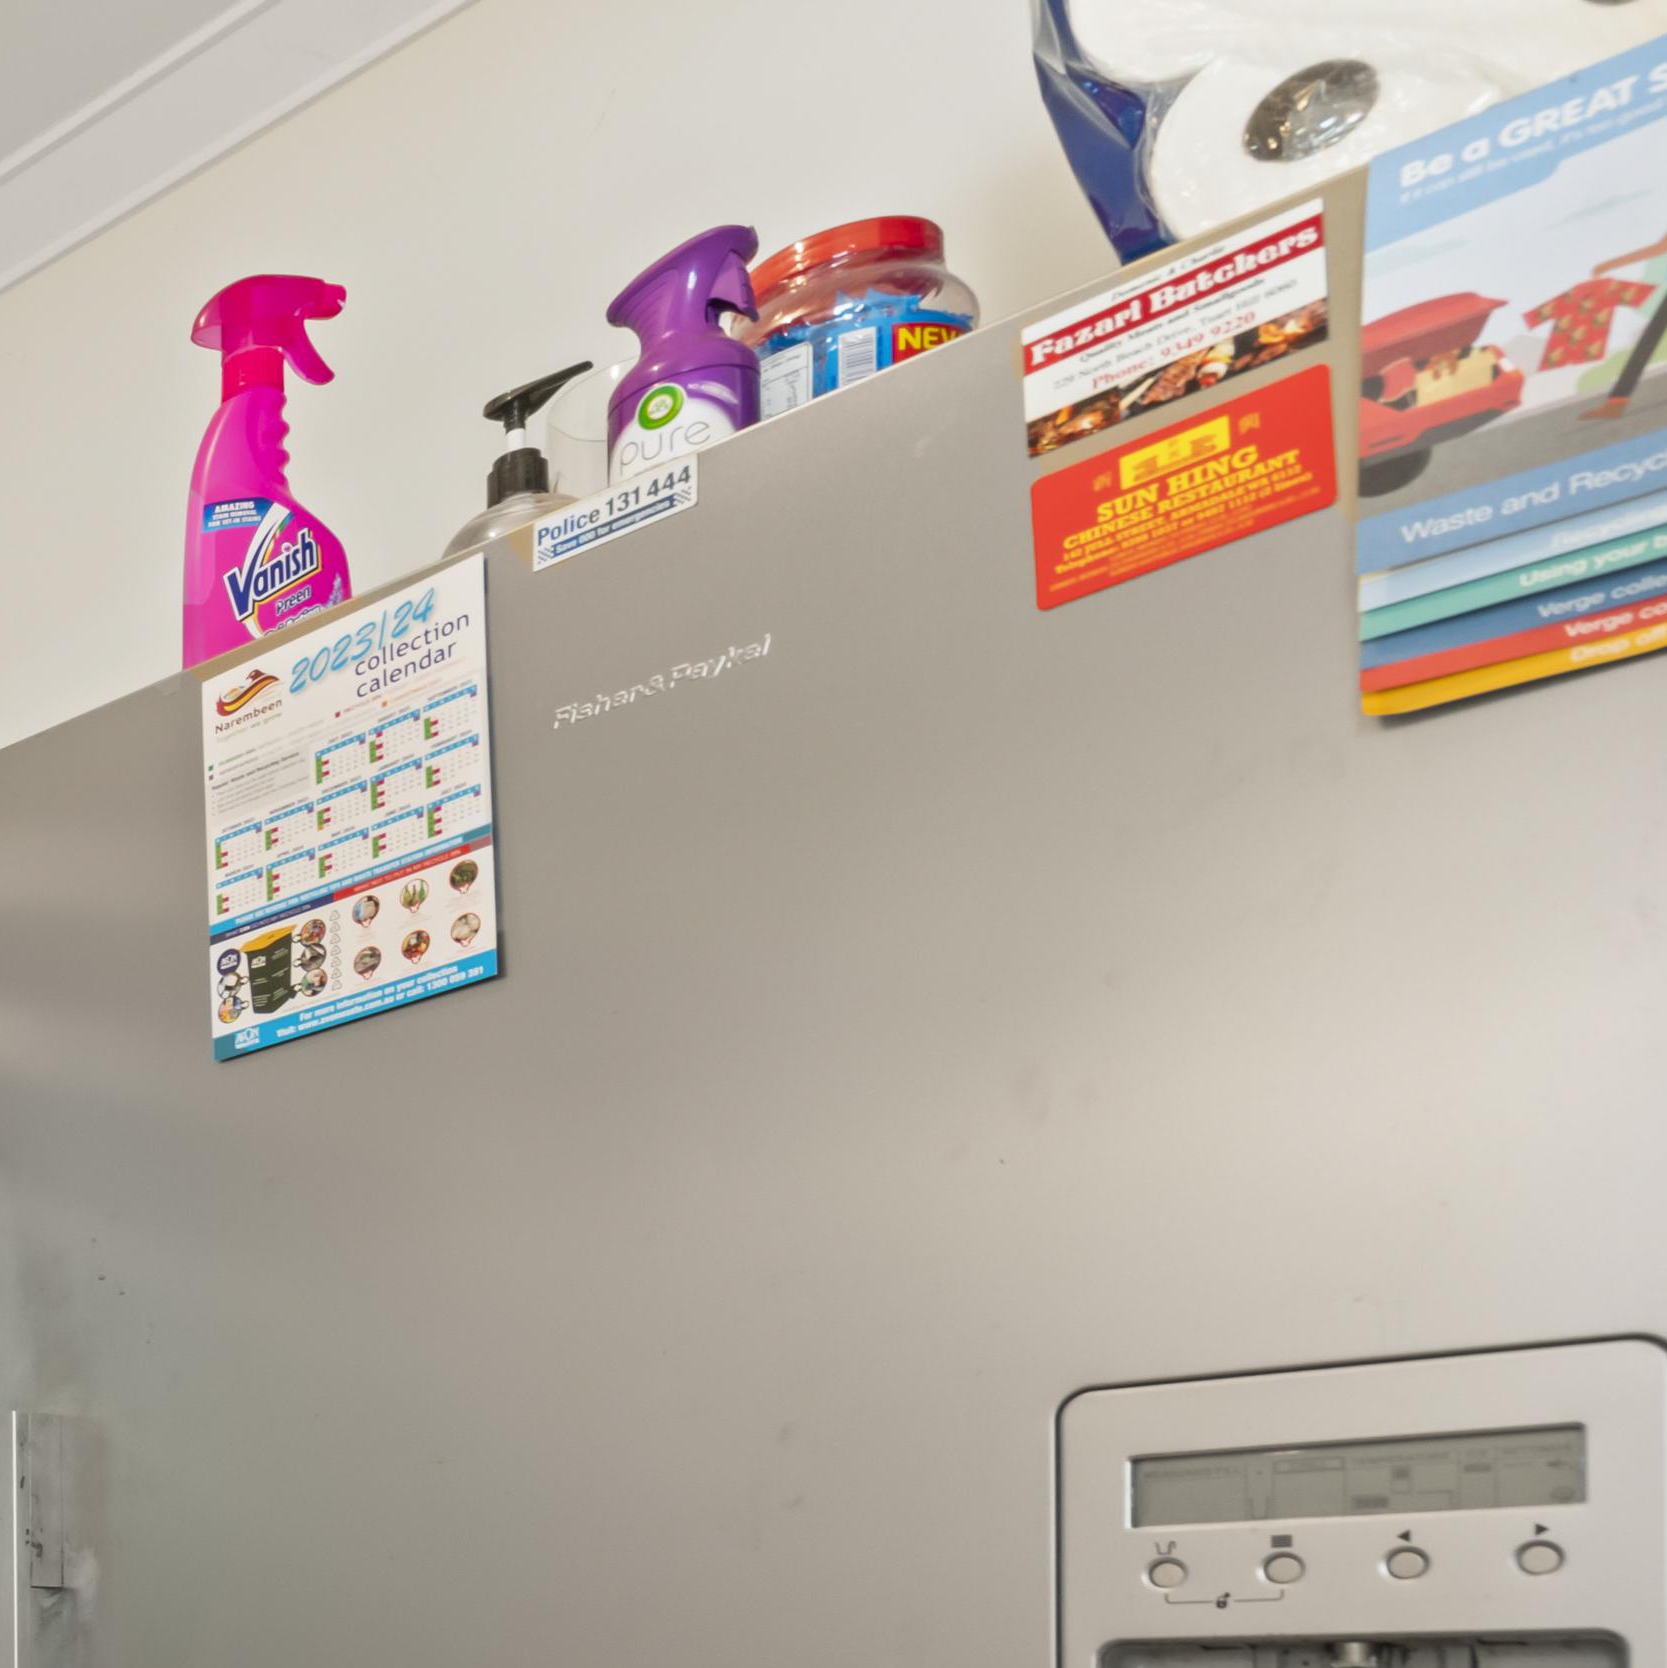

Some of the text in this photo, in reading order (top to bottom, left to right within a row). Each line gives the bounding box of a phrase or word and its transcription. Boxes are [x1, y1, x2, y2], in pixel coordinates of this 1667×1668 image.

[1399, 148, 1453, 189] Be
[1461, 136, 1489, 165] a
[1498, 74, 1638, 154] GREAT
[1149, 228, 1318, 310] Butchers
[620, 421, 711, 477] pure
[214, 501, 254, 513] AMAZING
[537, 466, 690, 544] Police 131 444
[1063, 508, 1154, 549] CHINESE
[1157, 452, 1300, 512] RESTAURANT
[1097, 485, 1159, 522] SUN
[1166, 447, 1258, 494] HING
[1400, 505, 1494, 543] Waste
[1501, 481, 1561, 515] and
[224, 524, 317, 618] Vanish
[1594, 541, 1649, 572] your
[276, 586, 312, 616] Preen
[1537, 591, 1606, 618] Verge
[1565, 612, 1634, 637] Verge
[354, 613, 469, 675] collection
[356, 641, 457, 697] calendar
[215, 698, 282, 734] Narembeen
